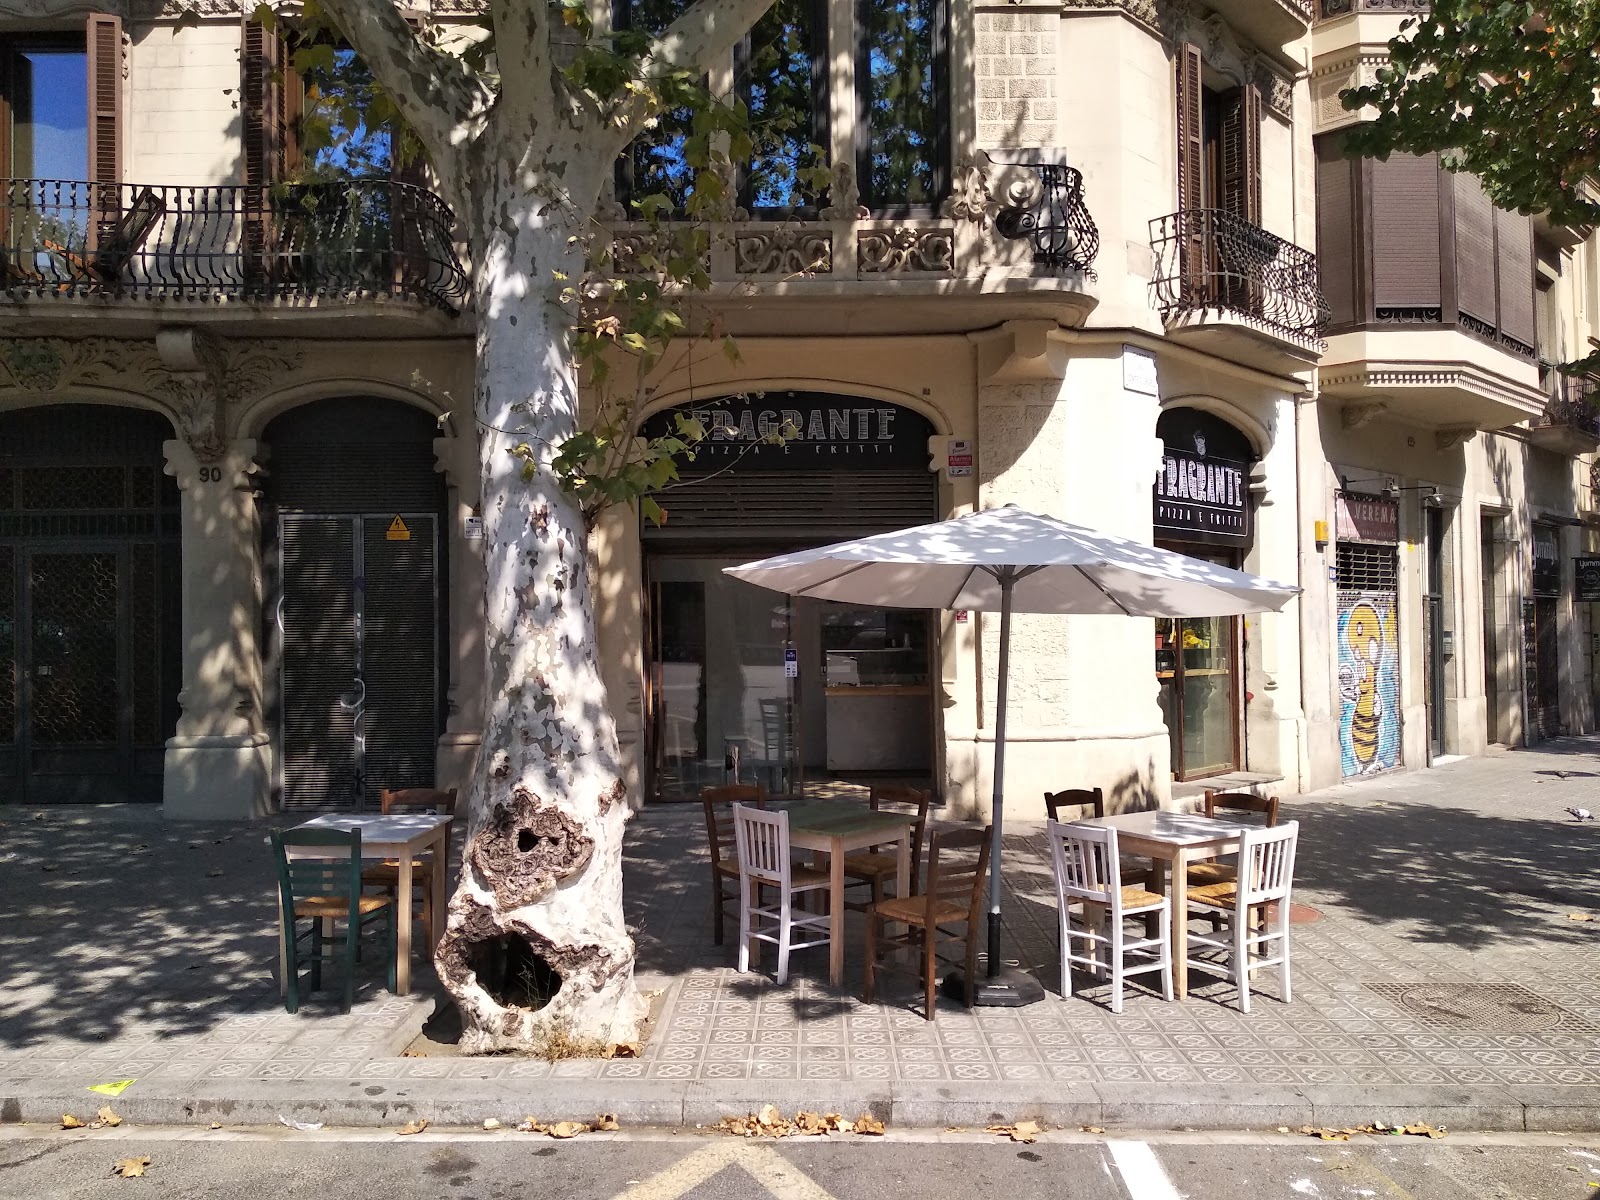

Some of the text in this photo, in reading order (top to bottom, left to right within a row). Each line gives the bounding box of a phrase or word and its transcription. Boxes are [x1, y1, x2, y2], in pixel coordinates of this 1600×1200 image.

[693, 408, 896, 441] FRAGRANTE
[694, 444, 894, 455] PIZZA E FRITTI
[199, 466, 222, 483] 90
[1156, 455, 1243, 507] FRAGRANTE
[1159, 506, 1242, 528] PIZZA E FRITTI
[1354, 502, 1397, 524] VEREMA
